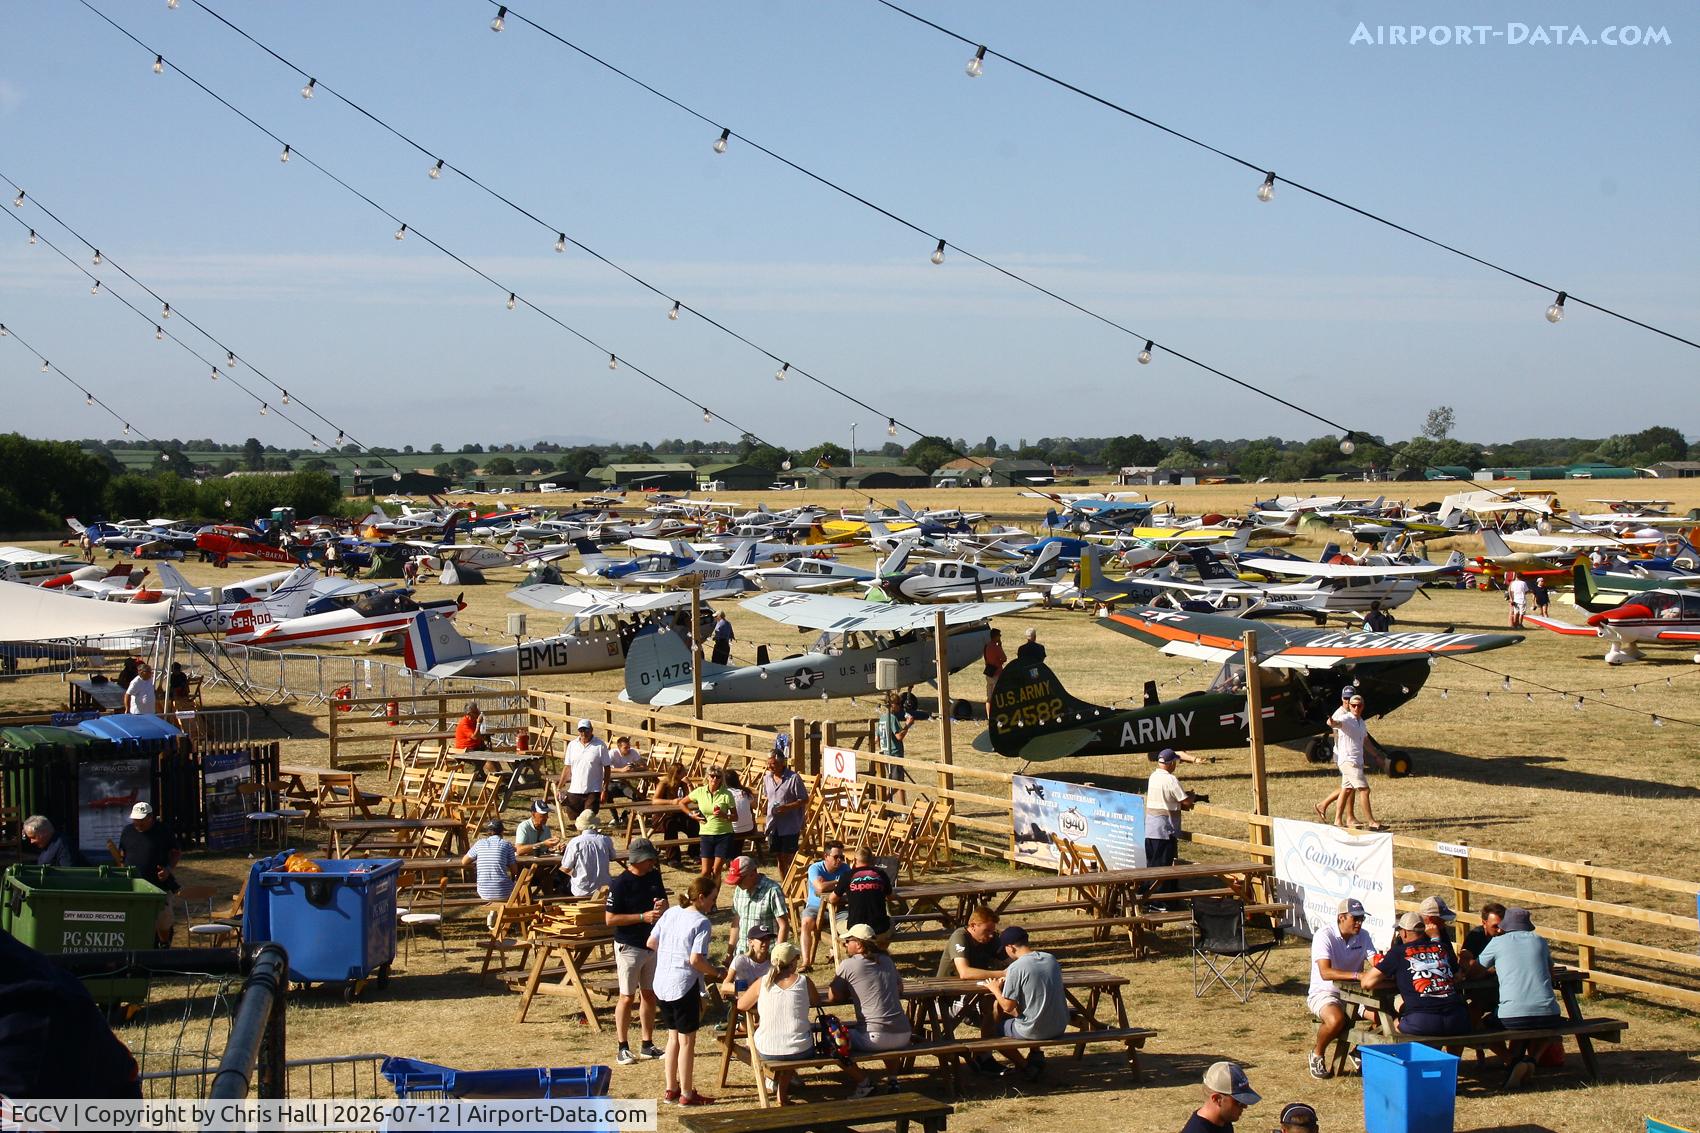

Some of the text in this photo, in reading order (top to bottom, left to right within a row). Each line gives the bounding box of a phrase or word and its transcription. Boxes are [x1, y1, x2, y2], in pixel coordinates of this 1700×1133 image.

[518, 643, 568, 671] BMG
[995, 697, 1064, 735] 24582
[1119, 710, 1196, 748] ARMY
[1061, 816, 1086, 832] 1940
[62, 931, 126, 948] PG SKIPS
